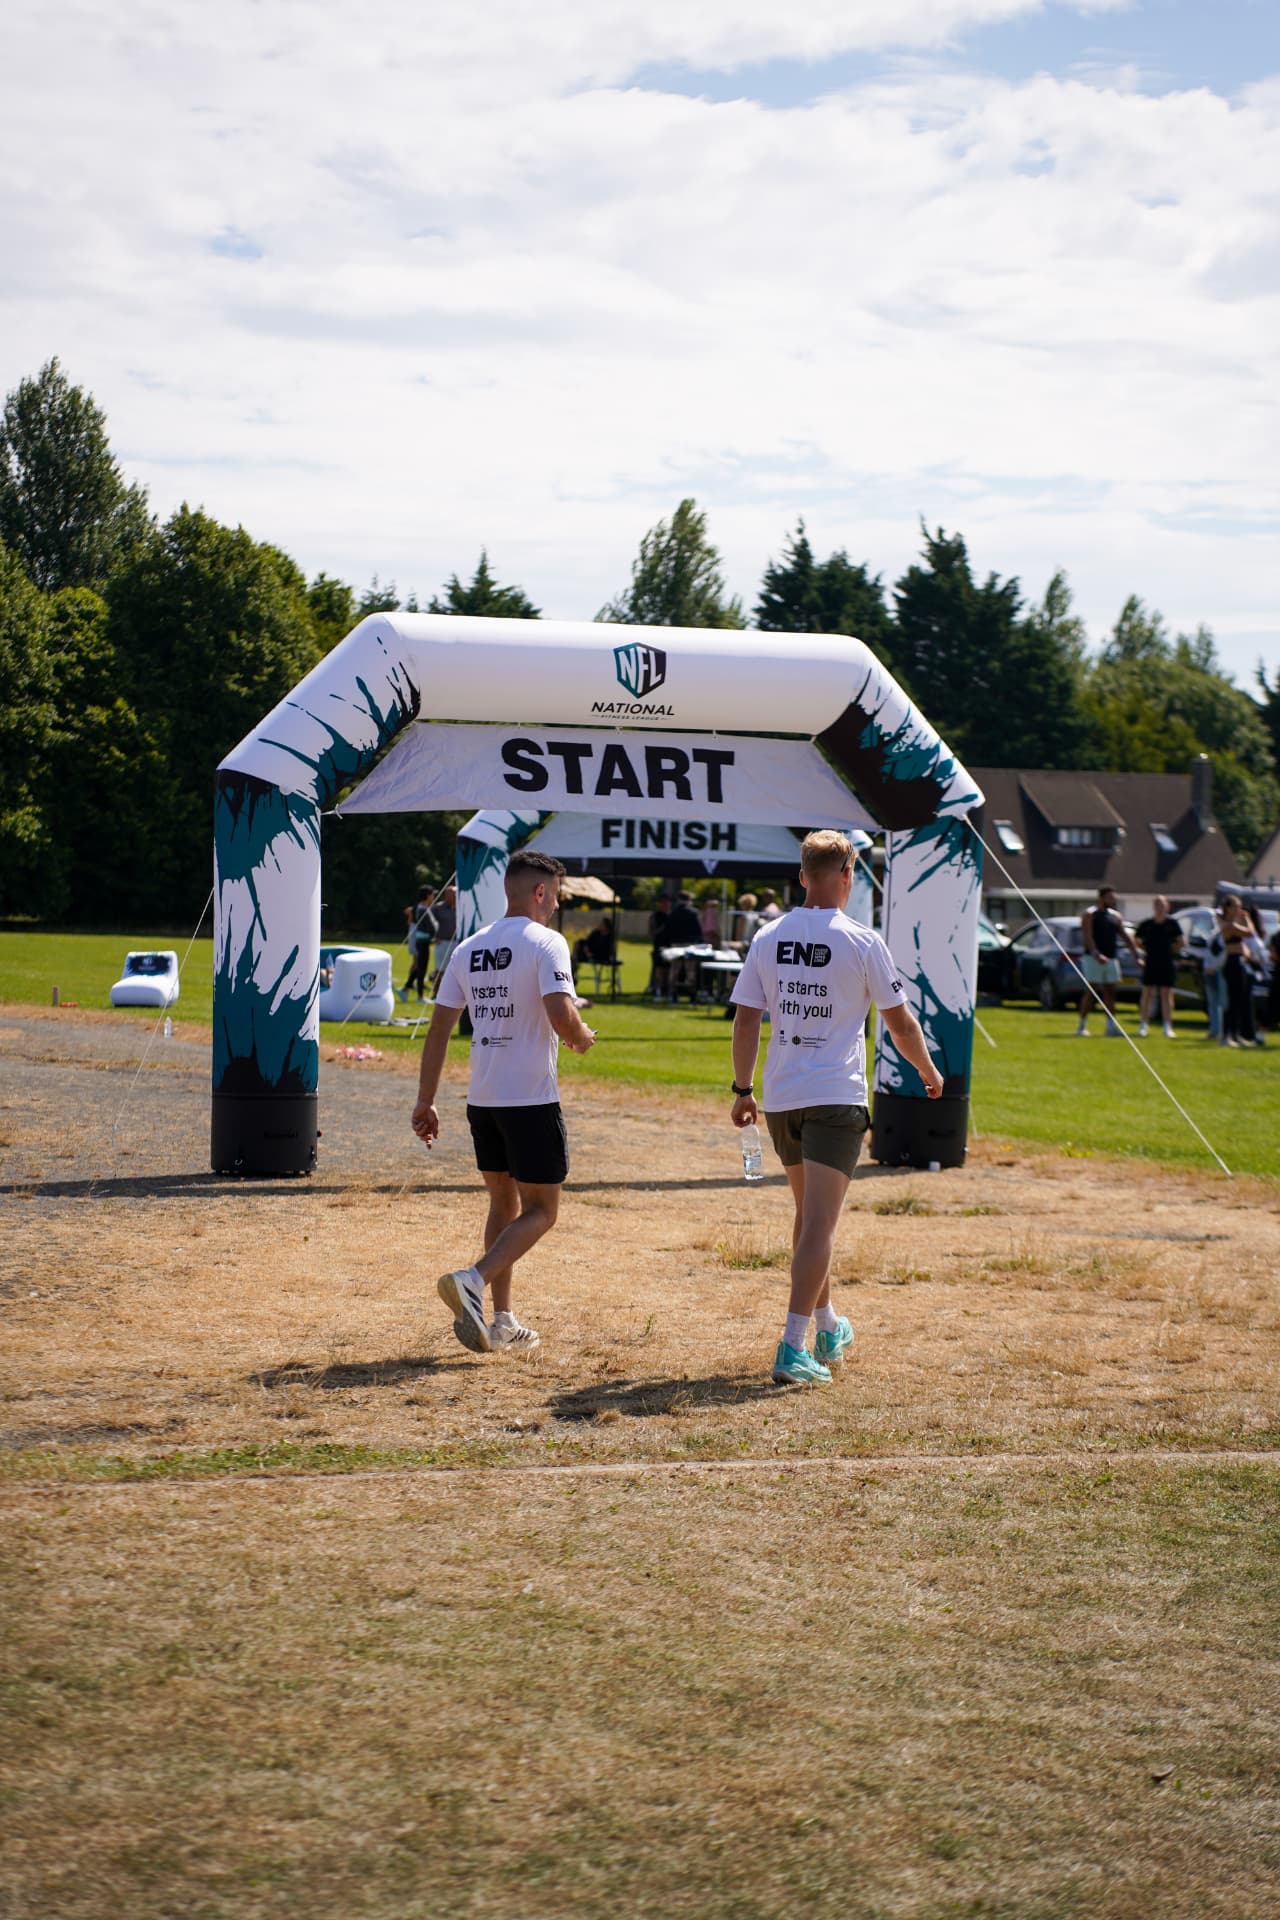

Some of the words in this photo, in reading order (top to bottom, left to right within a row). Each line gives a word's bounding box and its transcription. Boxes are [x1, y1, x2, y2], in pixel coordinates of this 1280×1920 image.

[618, 646, 662, 693] NFL
[591, 701, 675, 716] NATIONAL
[501, 738, 735, 803] START
[601, 818, 737, 851] FINISH
[470, 947, 512, 972] END
[776, 941, 831, 967] END
[554, 971, 570, 981] EN
[779, 979, 783, 993] t
[787, 981, 827, 997] starts
[891, 980, 903, 993] EN
[490, 1003, 514, 1020] you!
[780, 1000, 800, 1016] ith
[803, 1004, 832, 1020] you!
